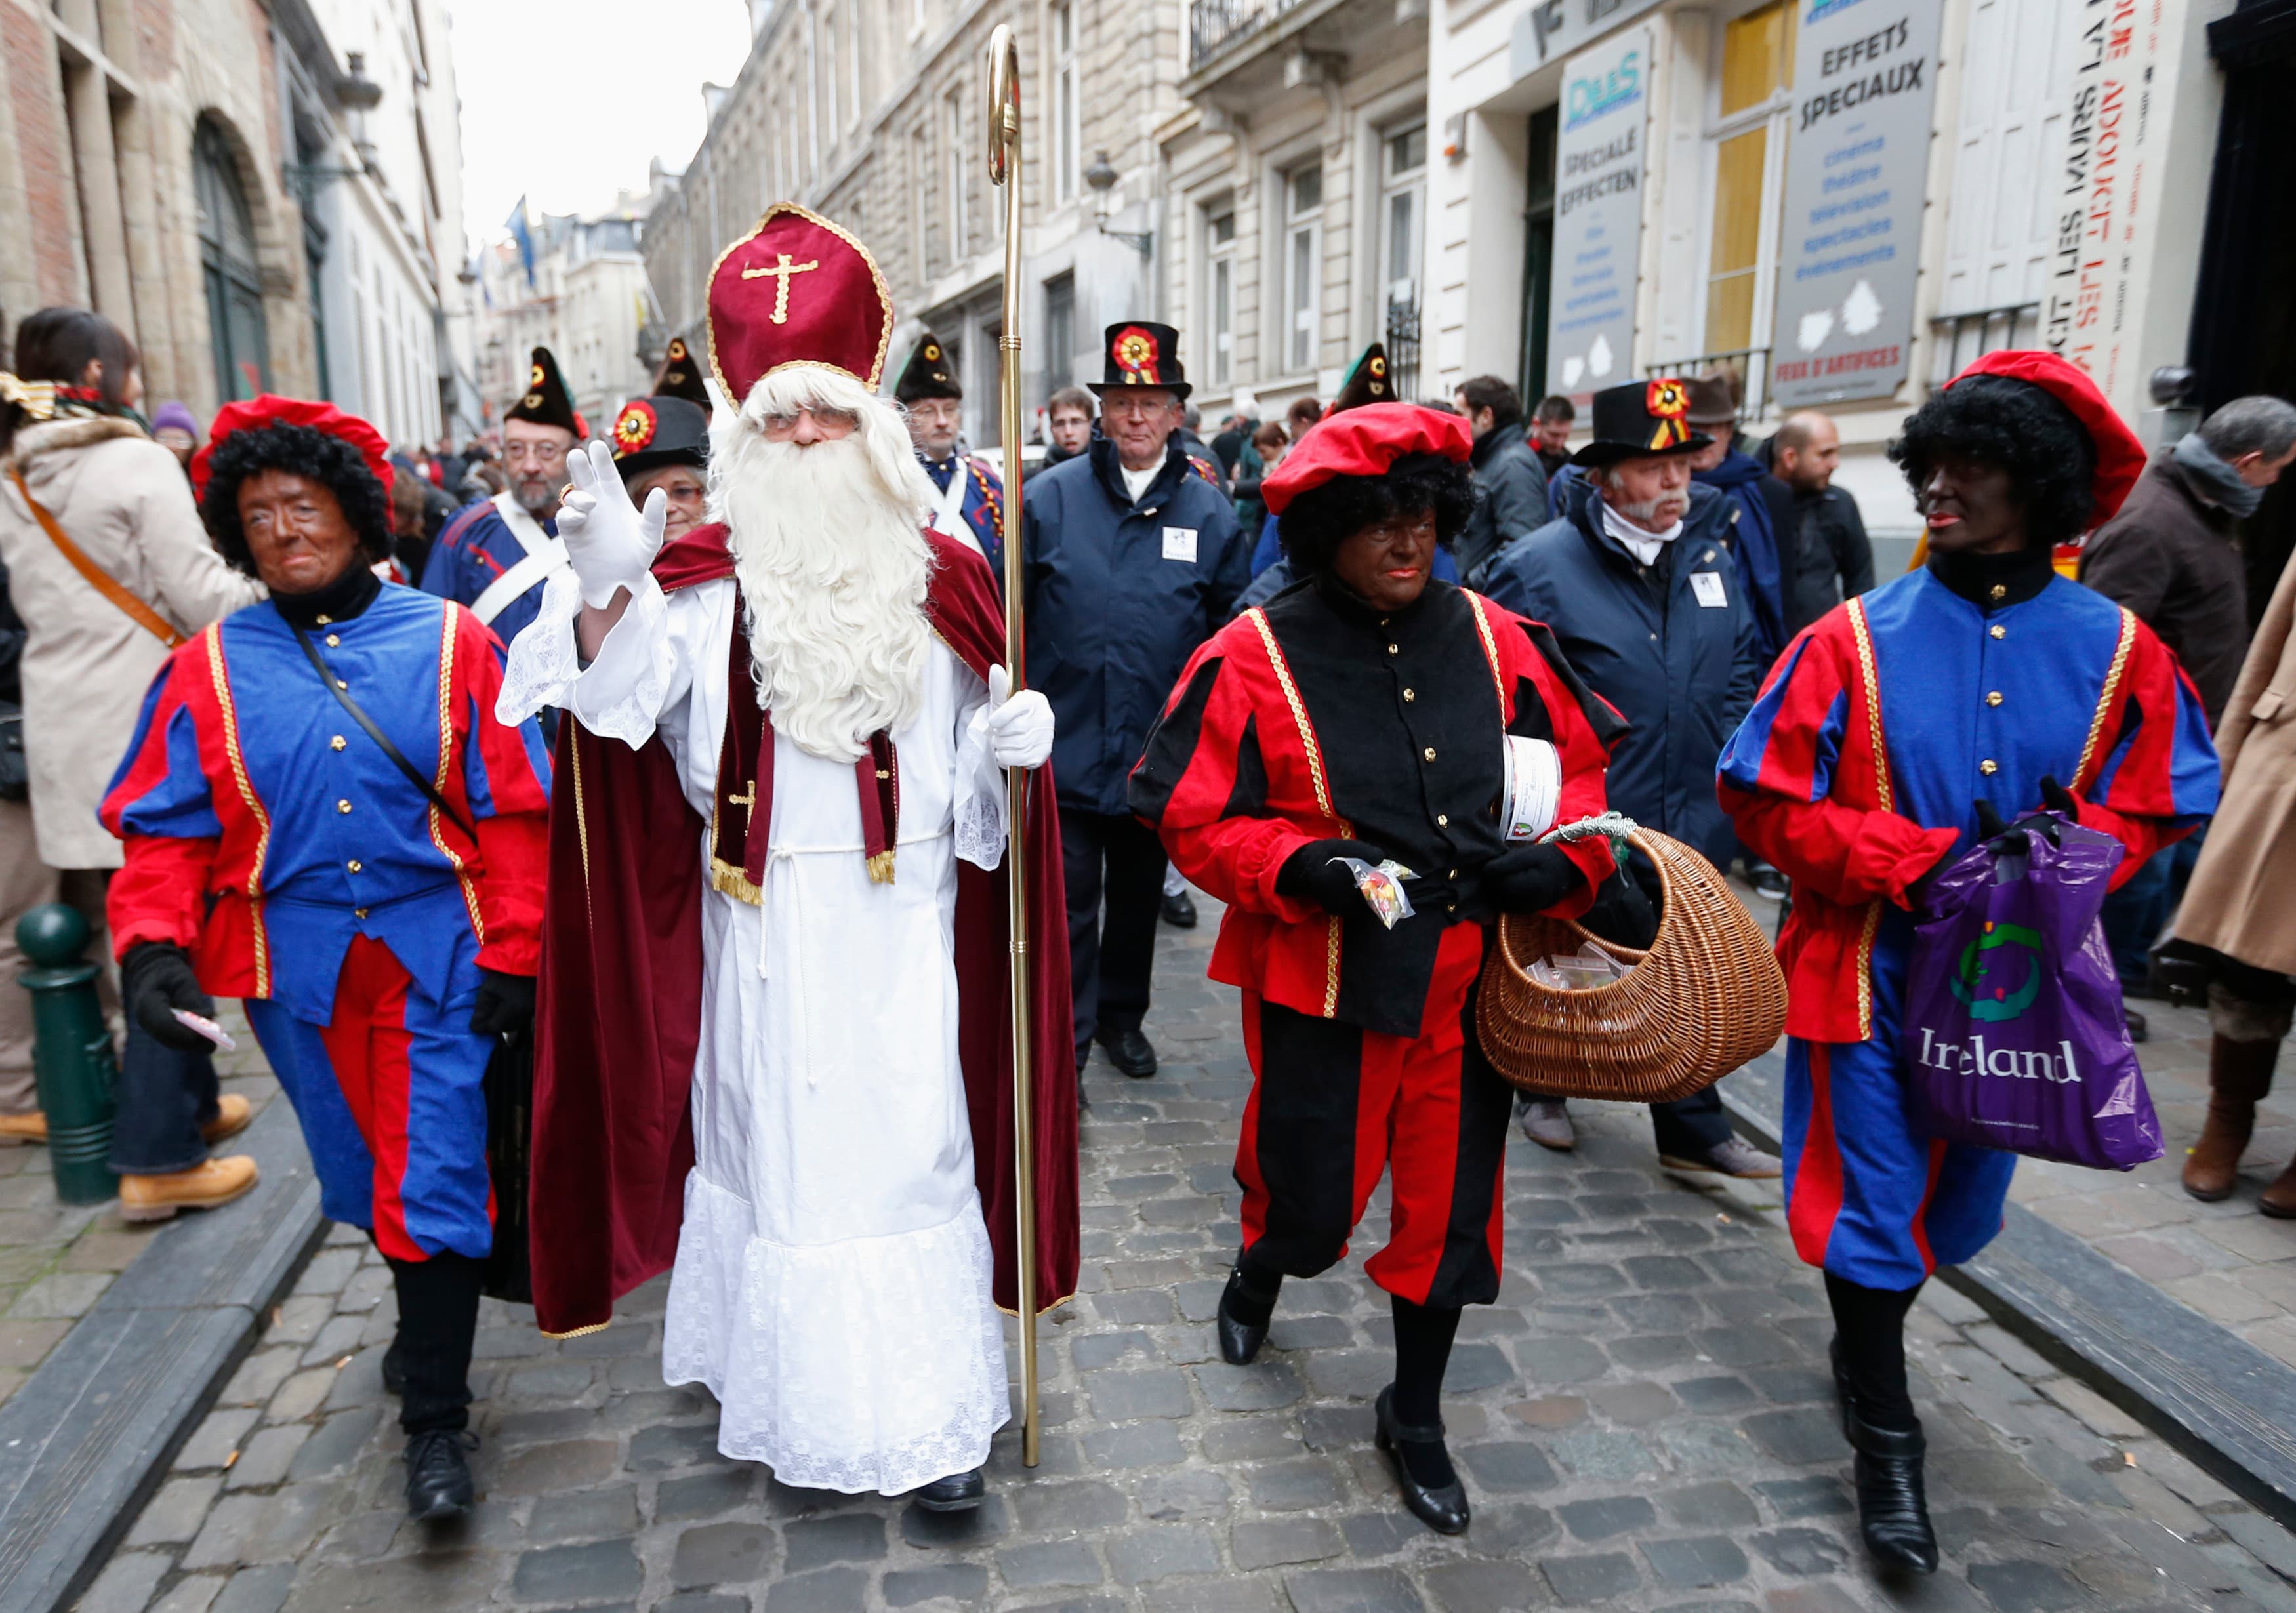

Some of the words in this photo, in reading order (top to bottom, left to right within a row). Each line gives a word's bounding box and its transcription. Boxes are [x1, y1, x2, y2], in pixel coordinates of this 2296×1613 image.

[1821, 16, 1908, 79] EFFETS
[1800, 55, 1926, 133] SPECIAUX
[2066, 85, 2097, 195] MURS
[1561, 165, 1638, 218] EFFECTEN
[2055, 209, 2083, 279] LES
[2076, 259, 2106, 330] LES
[1776, 361, 1811, 382] FEUX
[1919, 1027, 2081, 1084] Ireland
